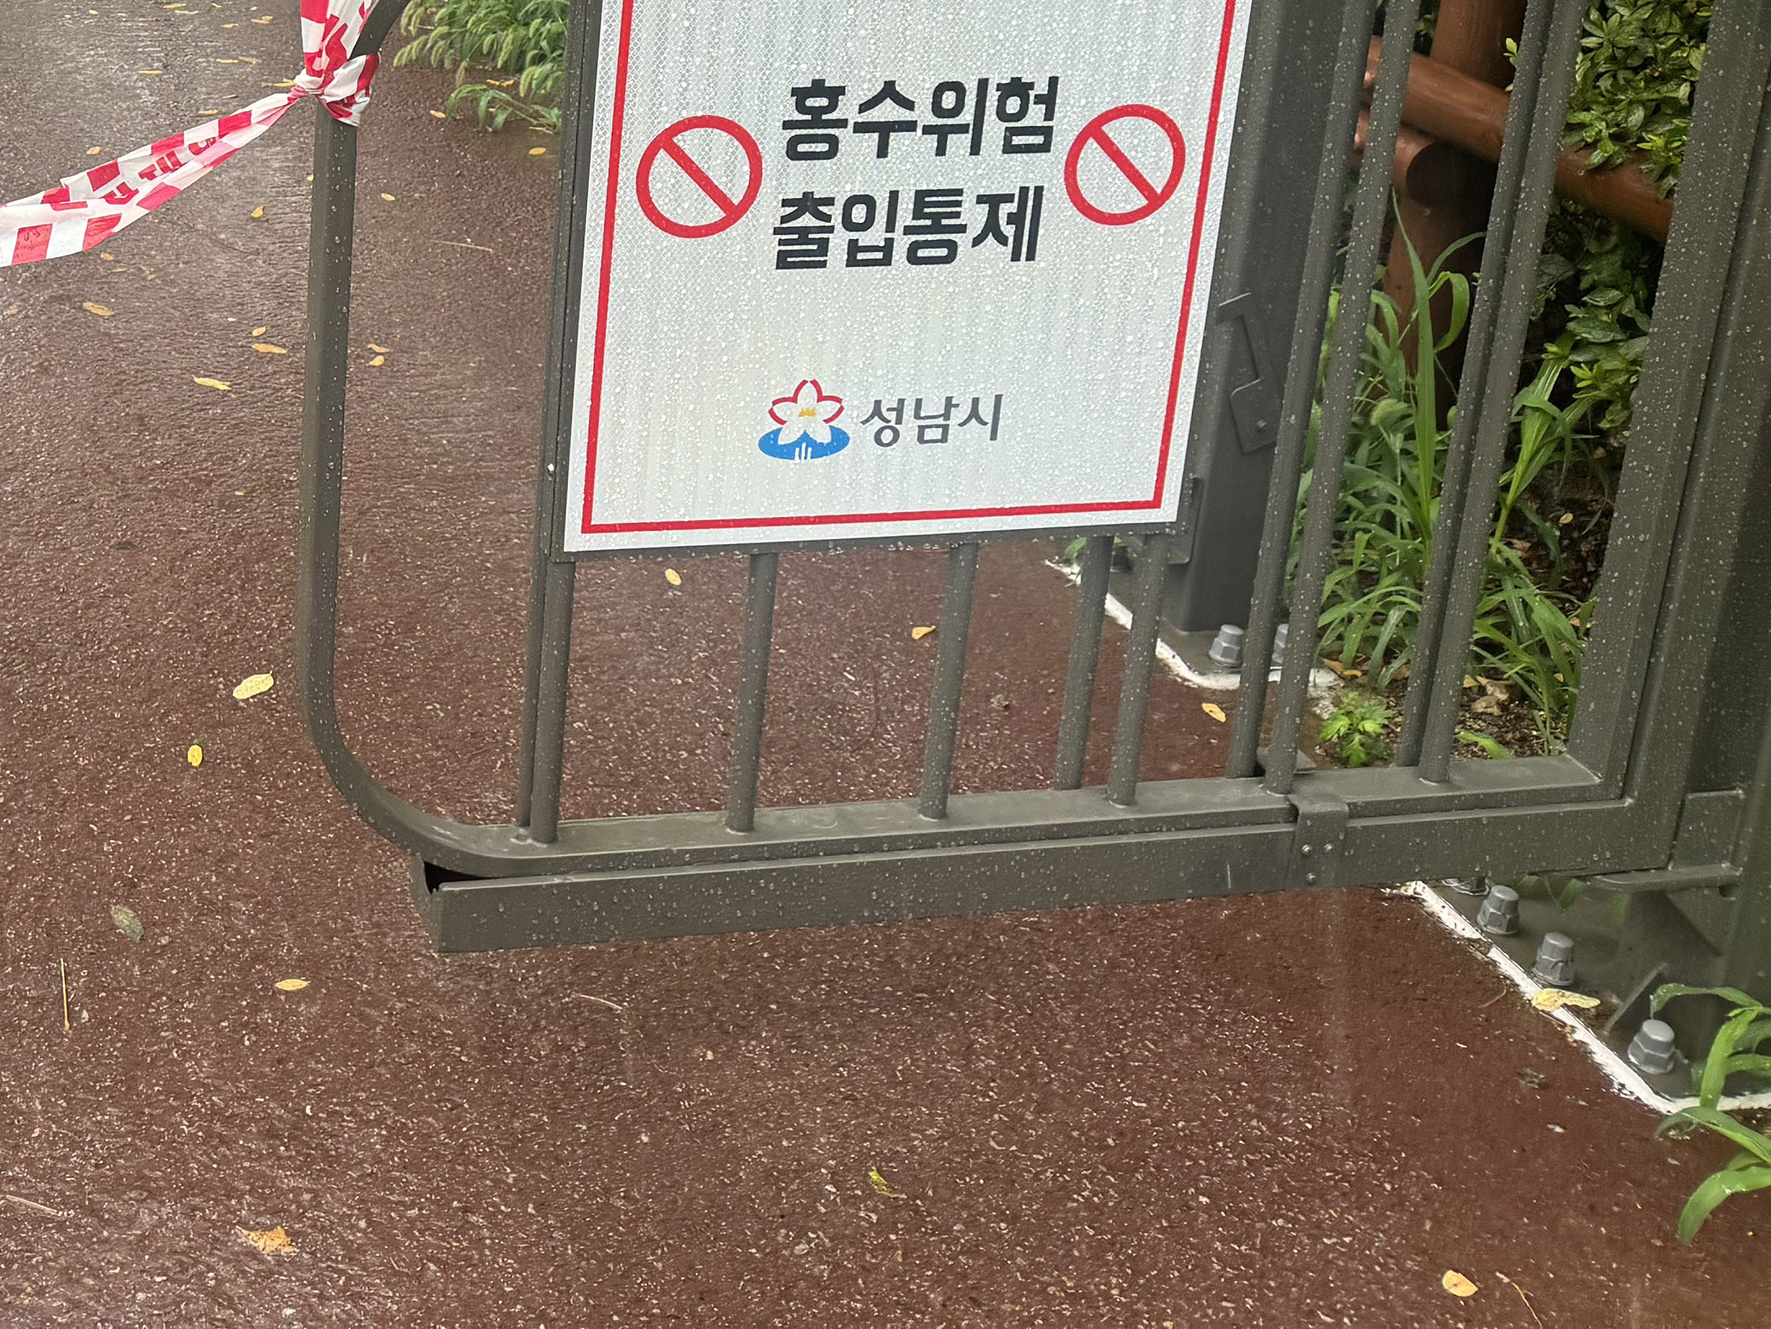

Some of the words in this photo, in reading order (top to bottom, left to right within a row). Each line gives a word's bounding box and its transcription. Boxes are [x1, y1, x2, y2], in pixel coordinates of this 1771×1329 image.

[782, 75, 1060, 162] 홍수위험
[772, 185, 1045, 270] 출입통제
[859, 393, 1004, 448] 성남시
